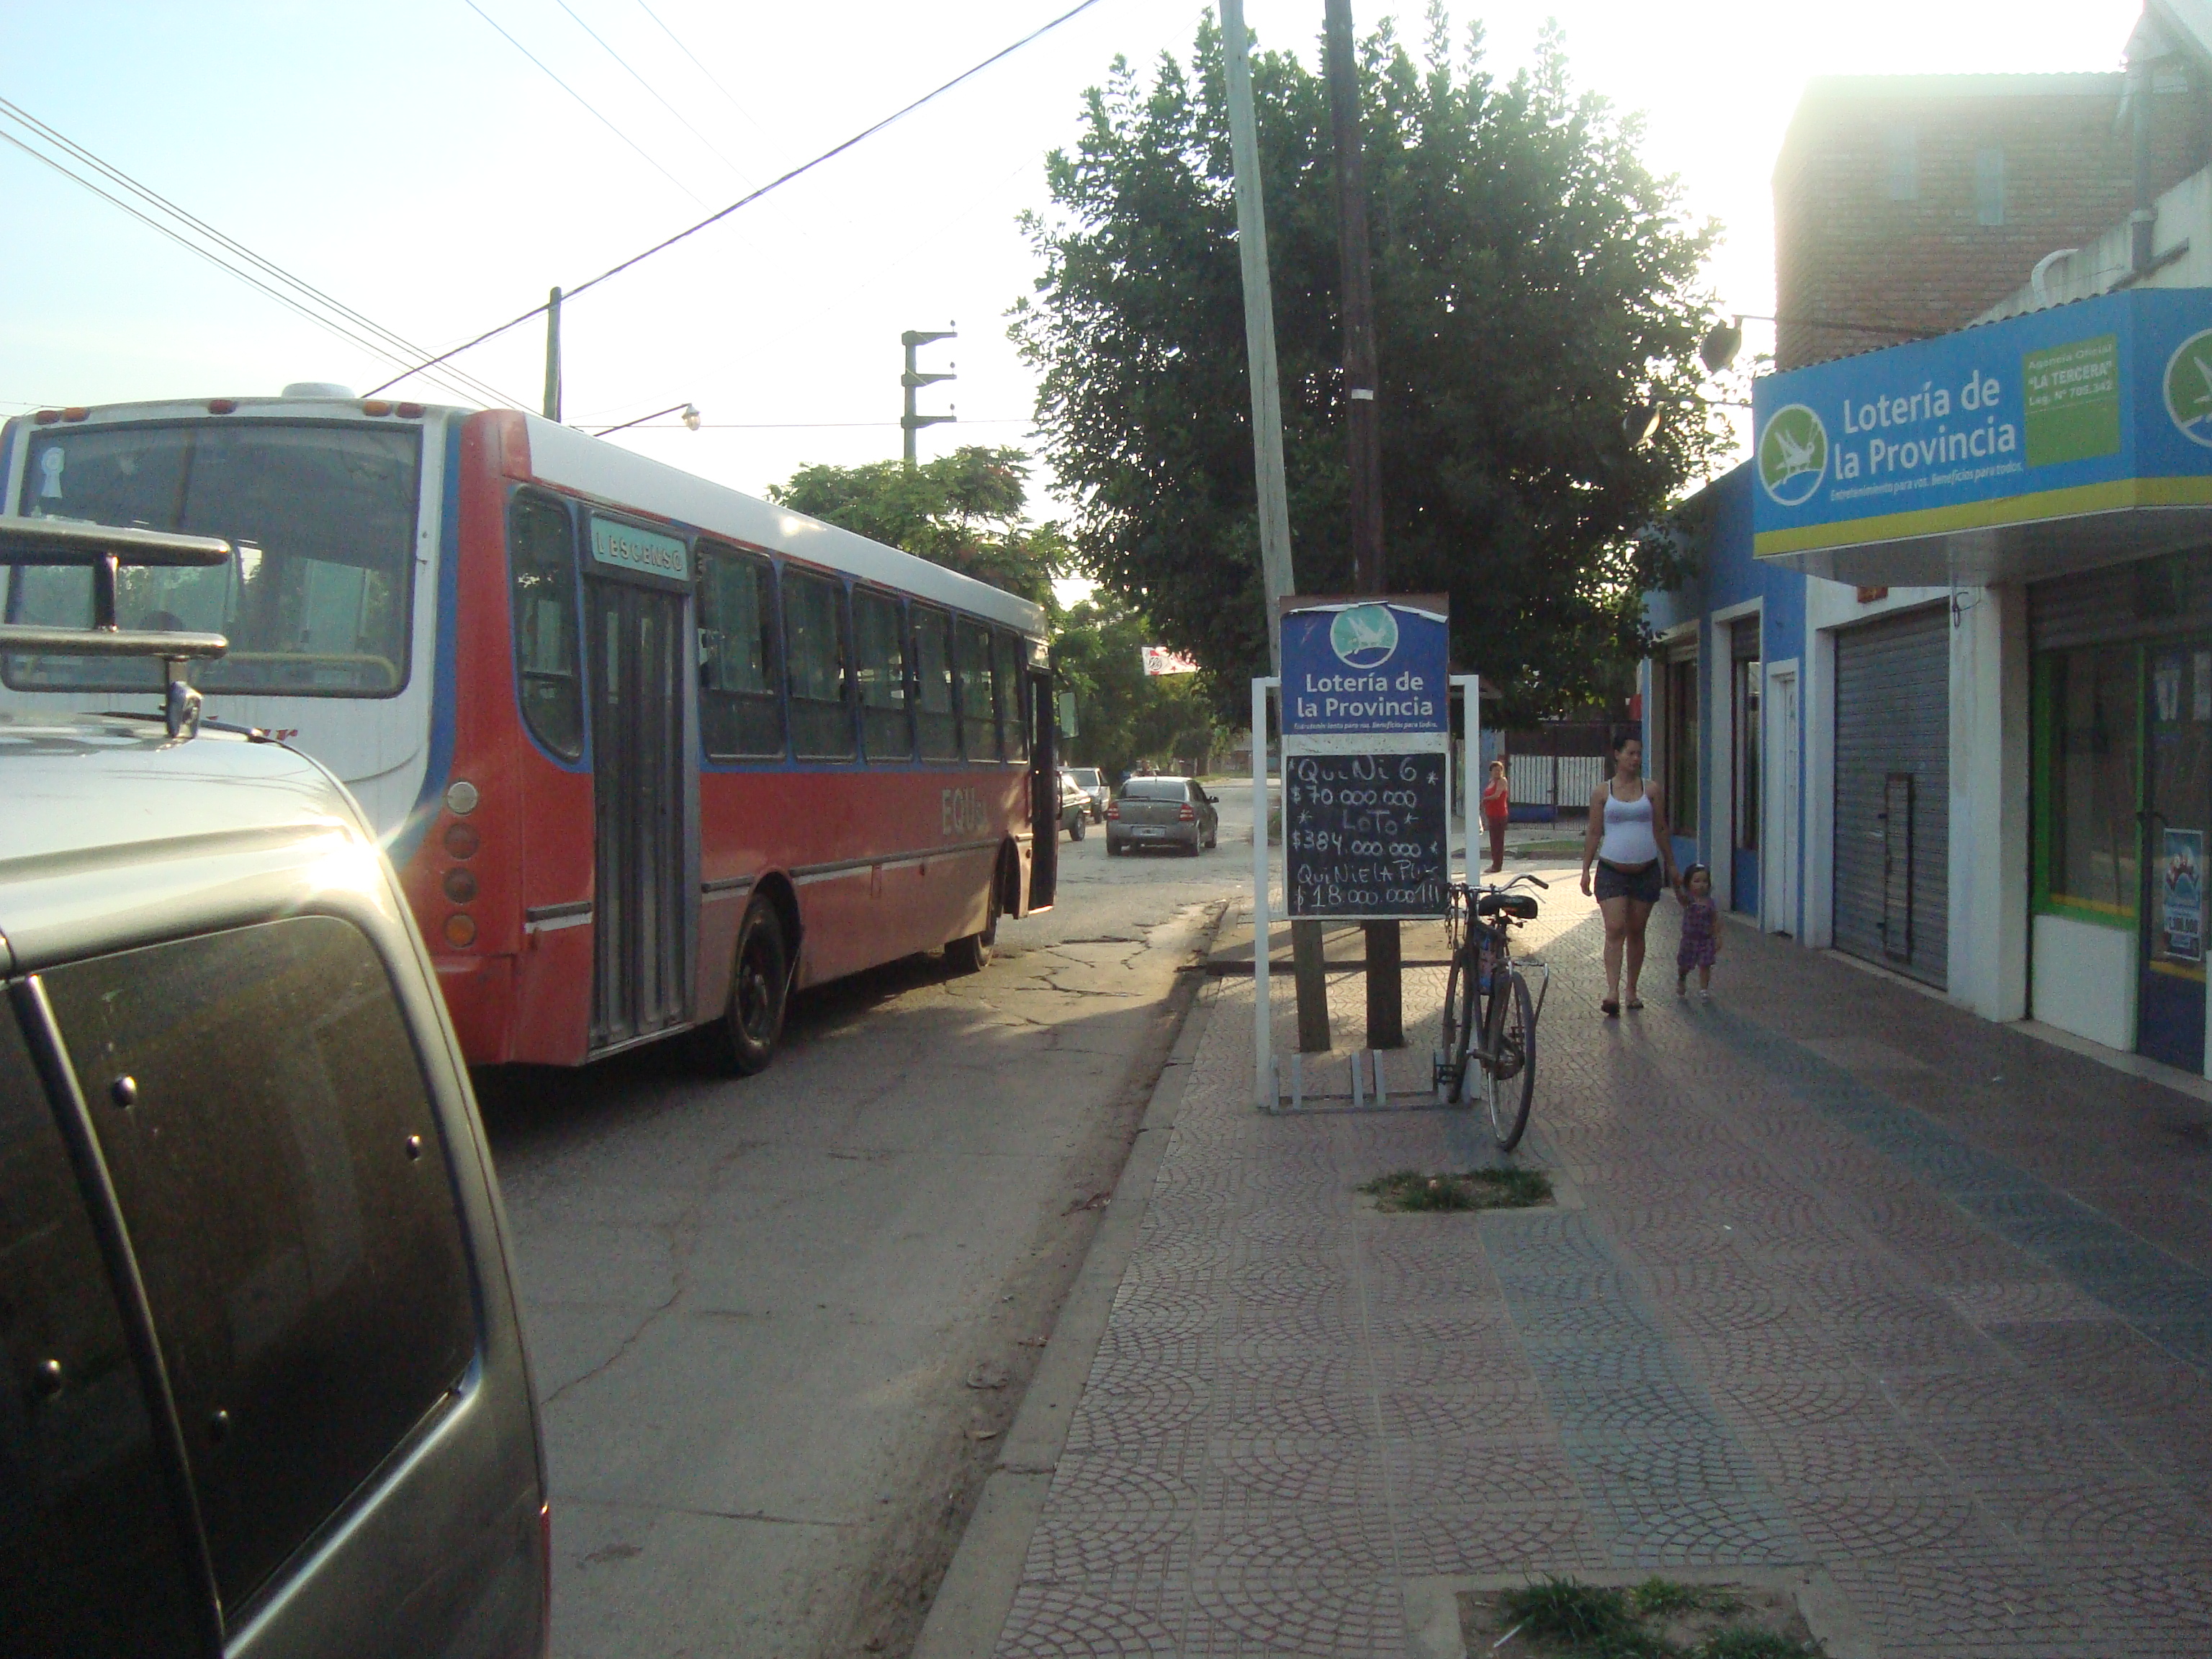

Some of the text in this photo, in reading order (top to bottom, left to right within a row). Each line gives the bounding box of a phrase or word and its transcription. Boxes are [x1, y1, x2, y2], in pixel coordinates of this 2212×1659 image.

[1843, 369, 2000, 433] Lotería de
[1835, 415, 2015, 480] la Provincia
[1305, 670, 1424, 693] Lotería de
[1298, 695, 1434, 718] la Provincia
[1399, 757, 1417, 782] 6
